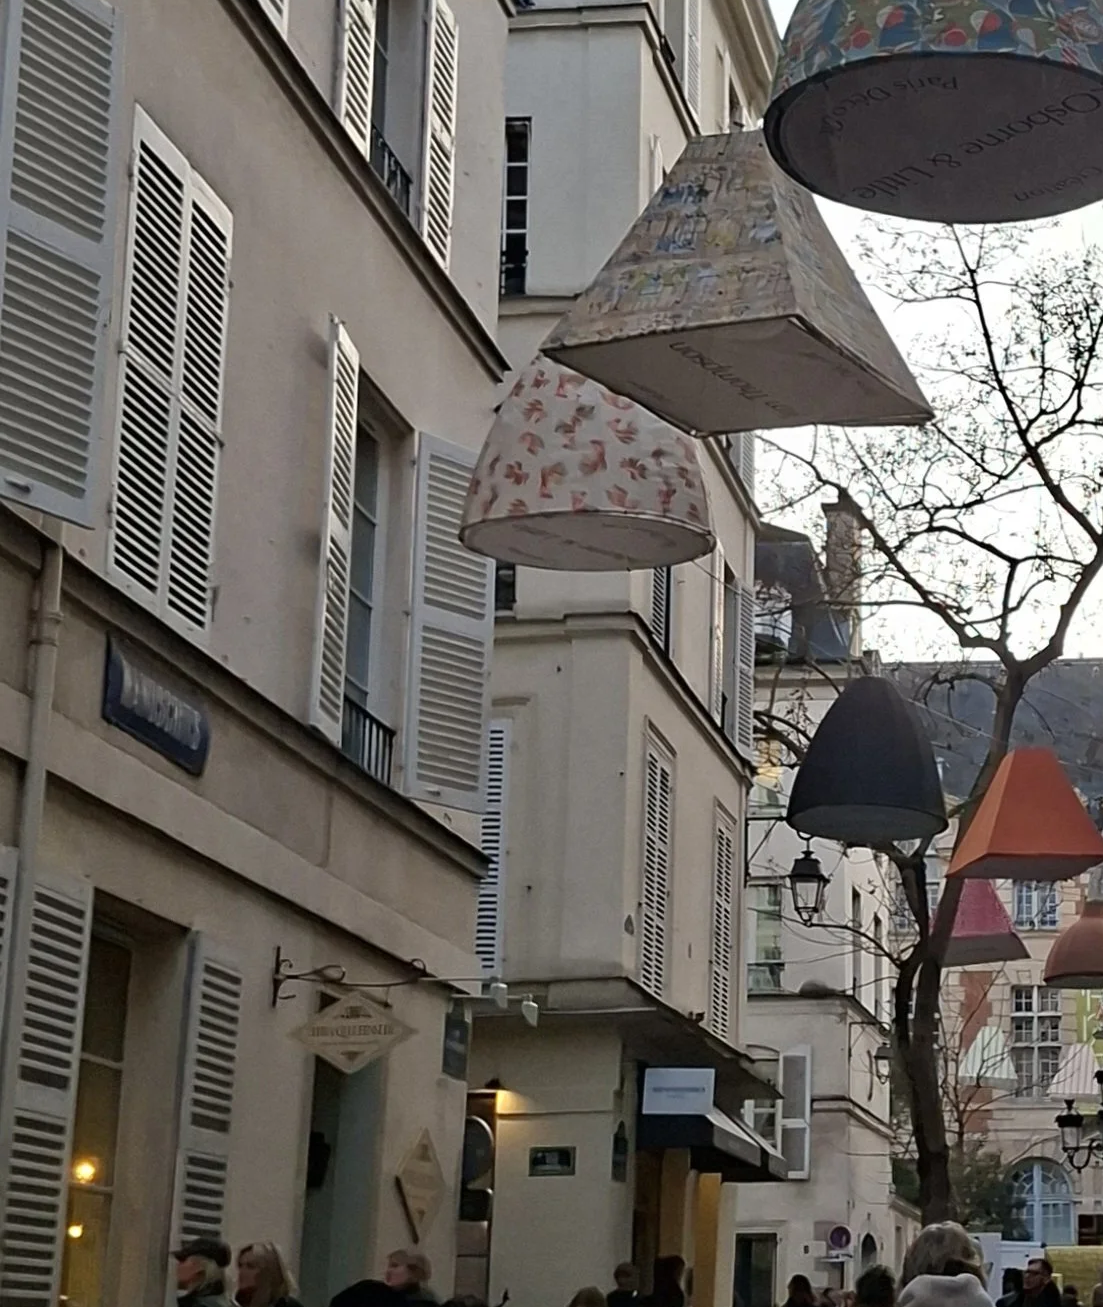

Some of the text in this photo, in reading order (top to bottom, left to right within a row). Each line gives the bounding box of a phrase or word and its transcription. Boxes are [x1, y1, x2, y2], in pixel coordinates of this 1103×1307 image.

[894, 75, 959, 93] Paris
[855, 92, 1101, 200] Osborne & Little
